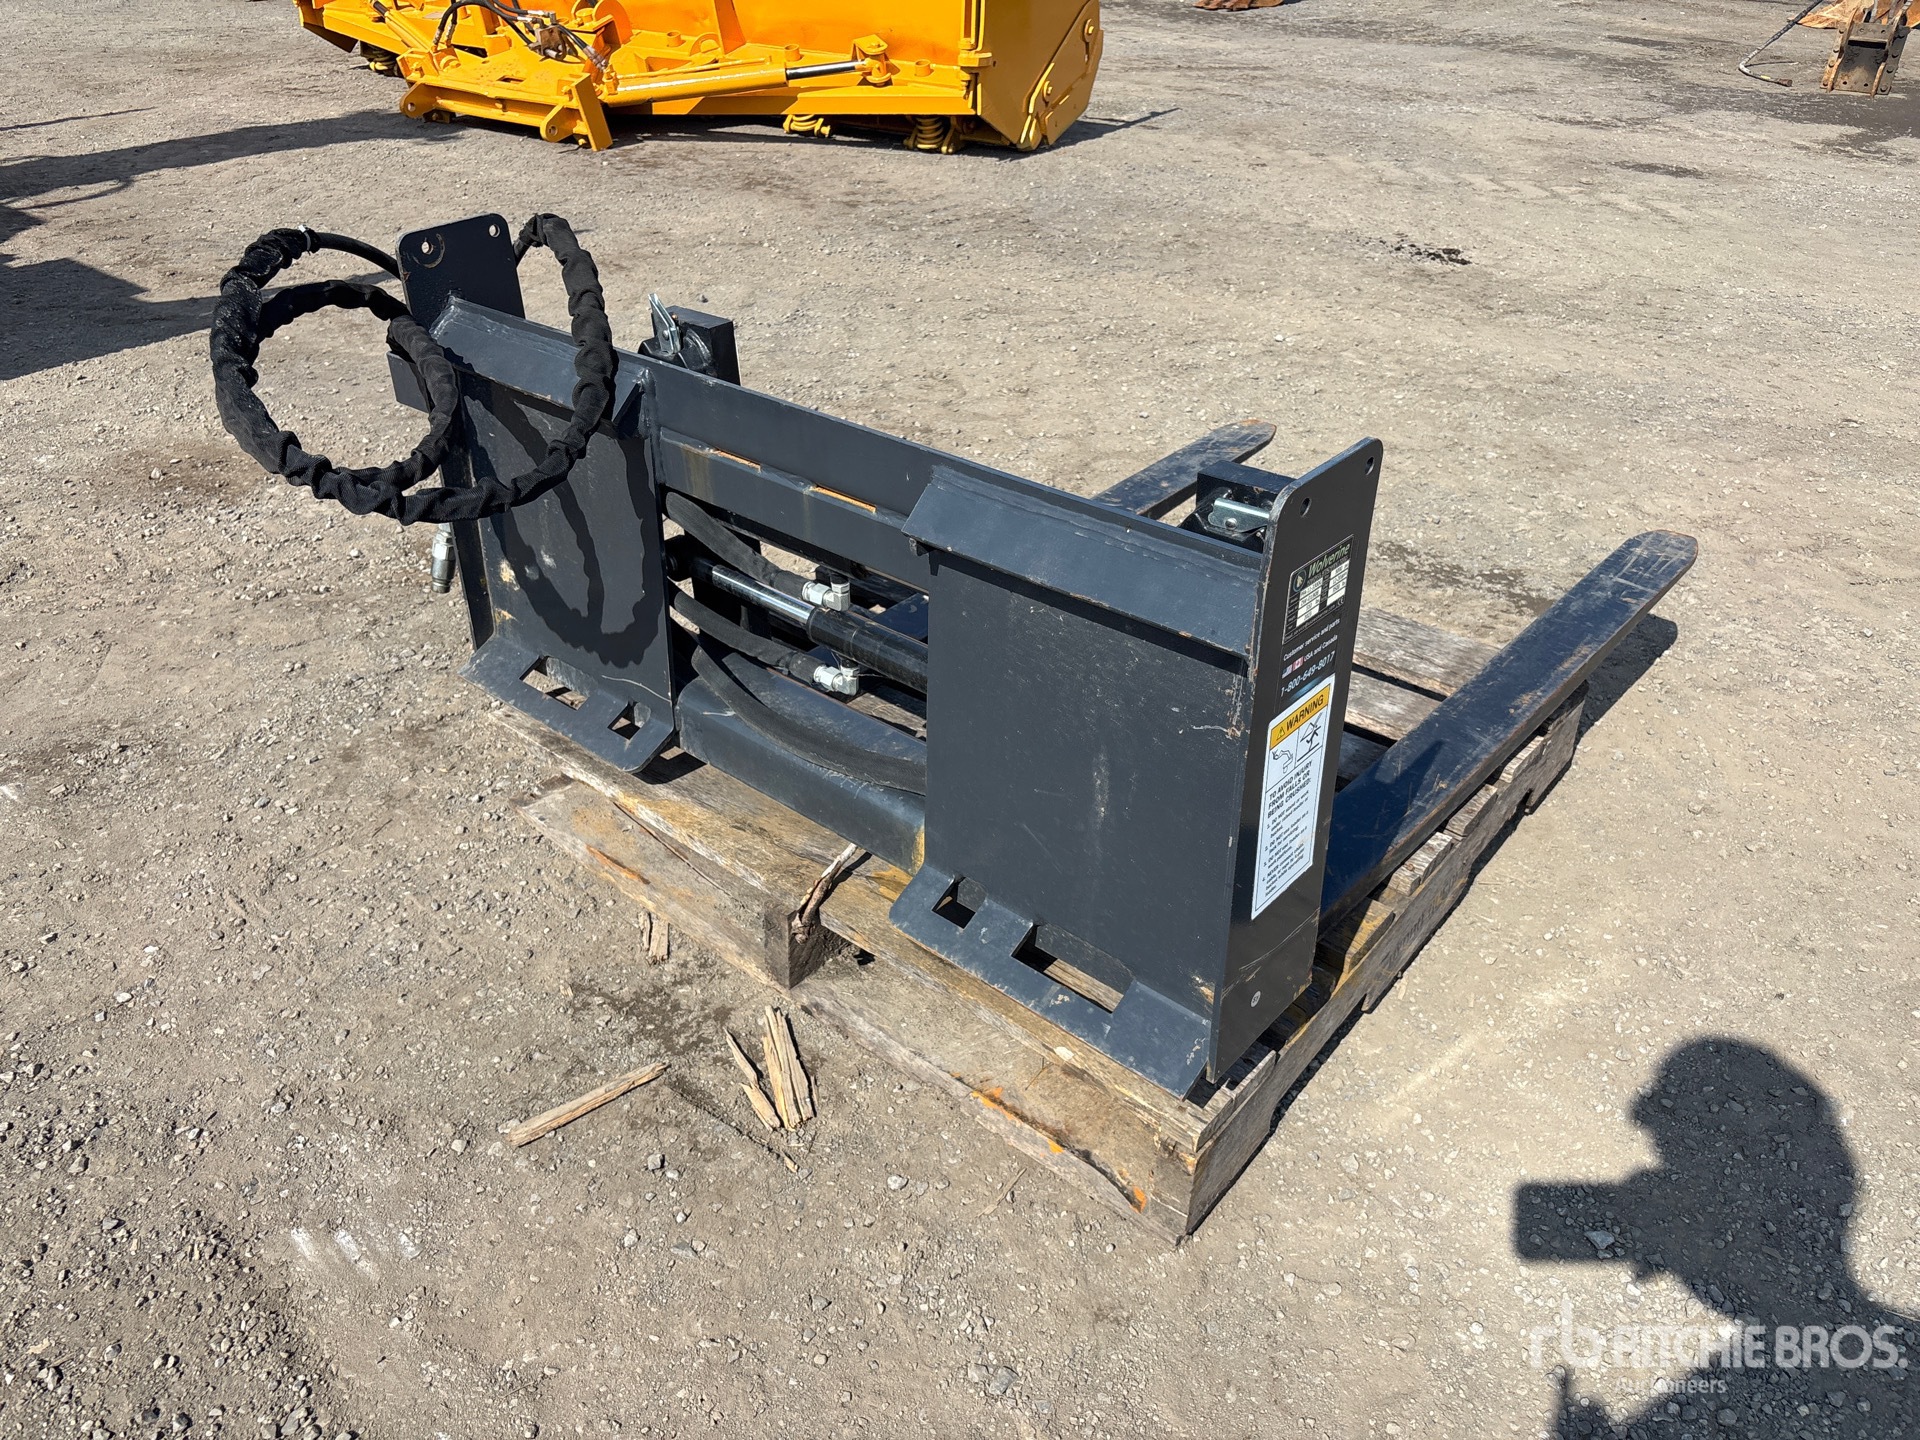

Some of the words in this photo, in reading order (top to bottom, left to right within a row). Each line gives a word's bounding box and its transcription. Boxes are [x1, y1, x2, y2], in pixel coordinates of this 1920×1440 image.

[1308, 543, 1350, 578] Wolverine
[1284, 643, 1304, 661] Customer
[1305, 632, 1320, 647] service
[1321, 624, 1329, 635] and
[1328, 618, 1340, 631] parts
[1304, 651, 1313, 662] USA
[1314, 644, 1322, 655] and
[1322, 635, 1338, 649] Canada
[1281, 650, 1336, 697] 1-800-649-8017
[1286, 694, 1324, 731] WARNING
[1268, 800, 1283, 818] BEING
[1285, 778, 1311, 803] CRUSHED:
[1269, 792, 1284, 809] FROM
[1285, 777, 1301, 794] FALLS
[1302, 770, 1310, 780] OR
[1270, 791, 1276, 800] TO
[1278, 777, 1293, 793] AVOID
[1294, 761, 1312, 779] INJURY
